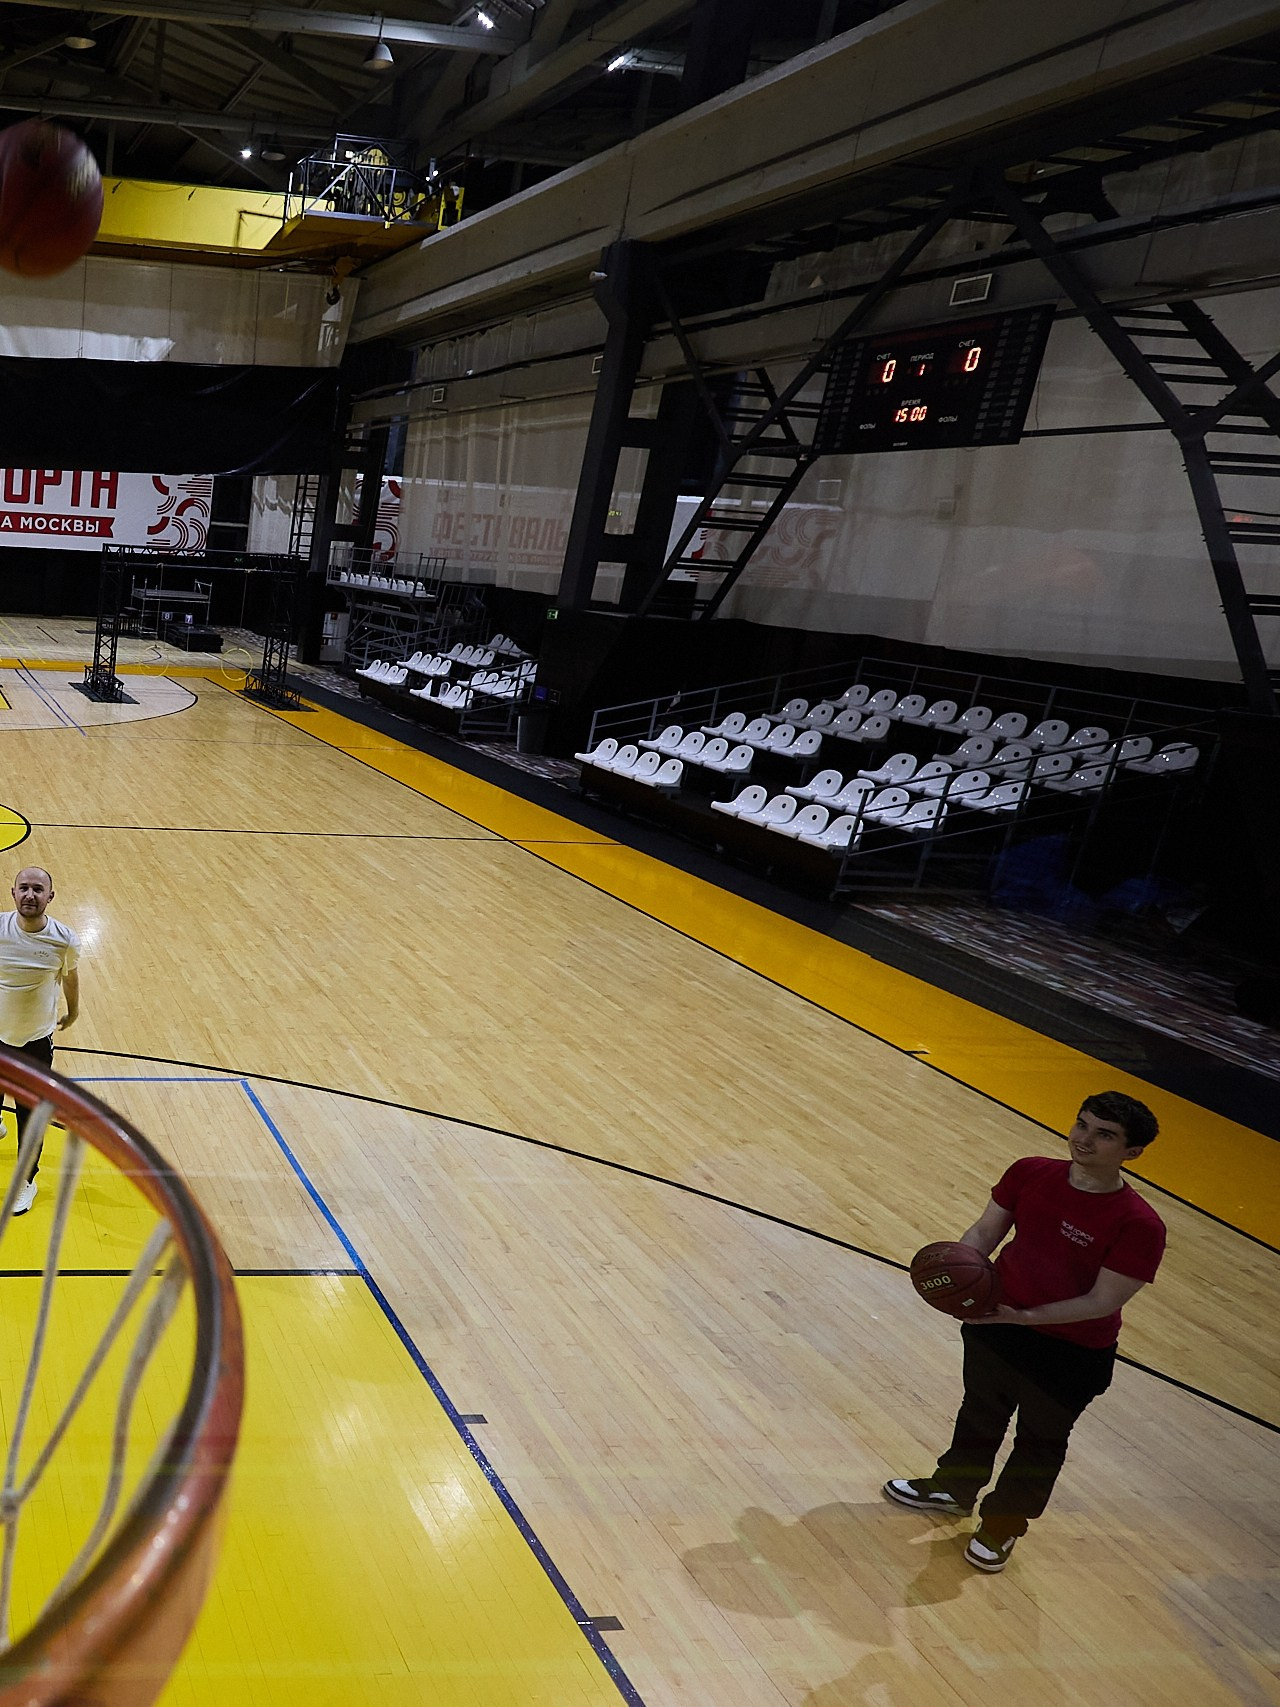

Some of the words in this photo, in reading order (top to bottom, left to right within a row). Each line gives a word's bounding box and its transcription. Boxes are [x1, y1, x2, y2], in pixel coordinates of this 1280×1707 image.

[964, 346, 982, 372] 0
[882, 359, 897, 383] 0
[919, 363, 926, 376] 1
[19, 515, 100, 534] МОСКВЫ
[920, 1275, 952, 1291] 3600
